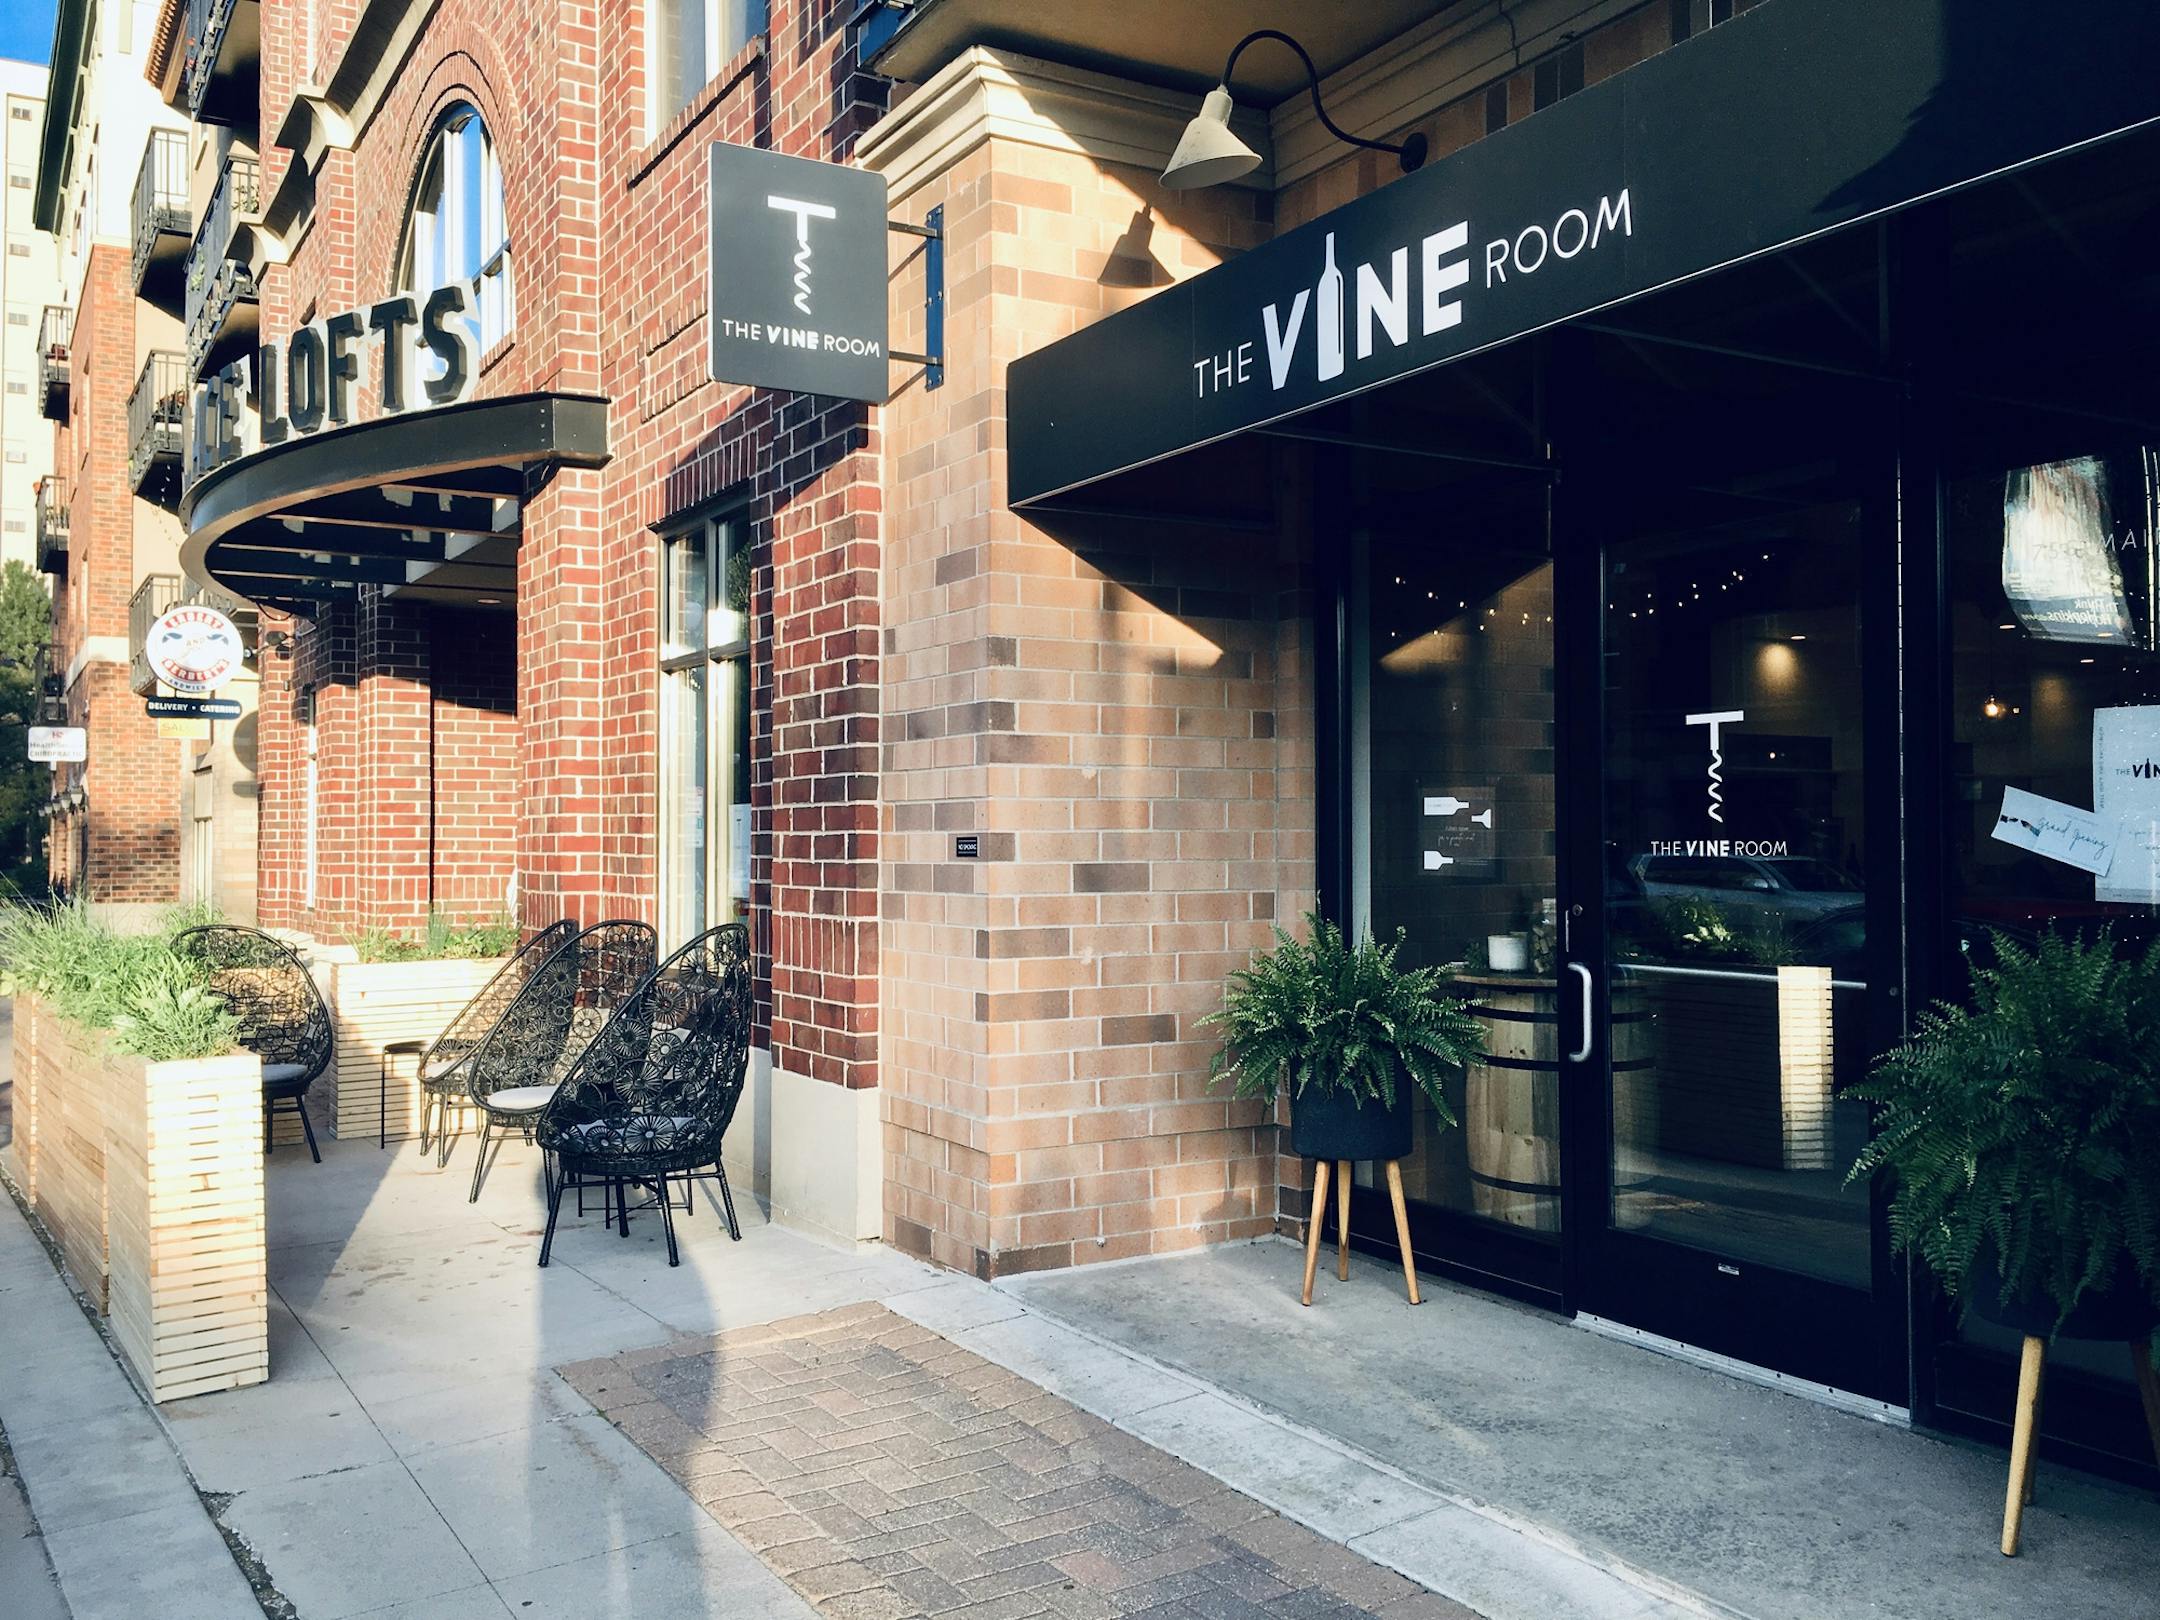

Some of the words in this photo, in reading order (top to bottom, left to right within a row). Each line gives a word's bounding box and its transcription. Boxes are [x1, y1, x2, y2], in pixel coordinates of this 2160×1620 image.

[1193, 342, 1253, 398] THE
[1262, 220, 1470, 390] VINE
[1486, 188, 1633, 289] ROOM
[722, 319, 762, 342] THE
[766, 325, 819, 350] VINE
[824, 334, 880, 358] ROOM
[260, 286, 467, 443] LOFTS
[2097, 528, 2160, 551] MAI
[148, 702, 189, 711] DELIVERY
[200, 705, 240, 713] CATERING
[2115, 768, 2130, 776] THE
[1650, 841, 1681, 856] THE
[1686, 840, 1730, 857] VINE
[1735, 841, 1787, 856] ROOM
